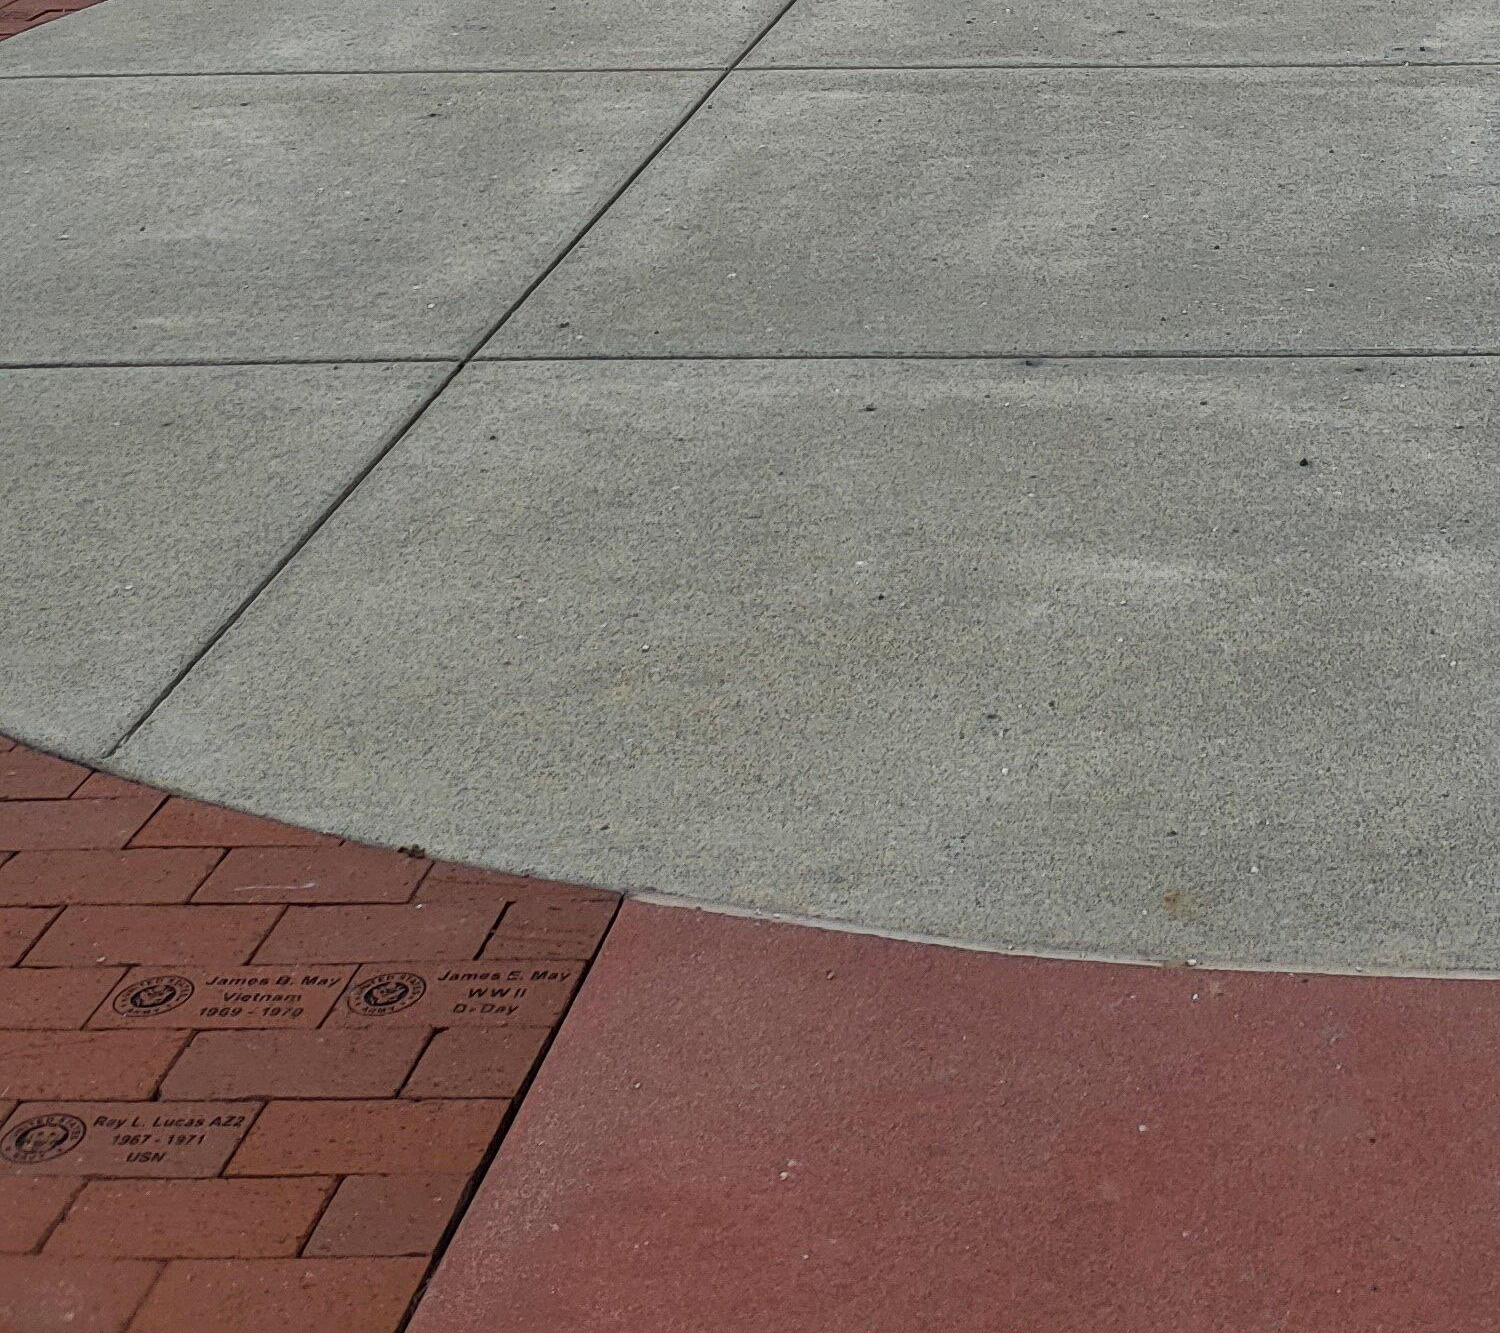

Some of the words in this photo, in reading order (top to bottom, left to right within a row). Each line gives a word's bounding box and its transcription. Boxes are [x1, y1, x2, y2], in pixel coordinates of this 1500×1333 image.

[206, 975, 270, 987] James
[300, 975, 341, 988] May
[437, 970, 501, 982] James
[530, 970, 572, 983] May
[223, 991, 301, 1003] Vietnam
[262, 1006, 304, 1018] 1970
[153, 1115, 203, 1128] Lucas
[112, 1134, 150, 1146] 1967
[167, 1134, 205, 1146] 1971
[126, 1151, 167, 1163] USN
